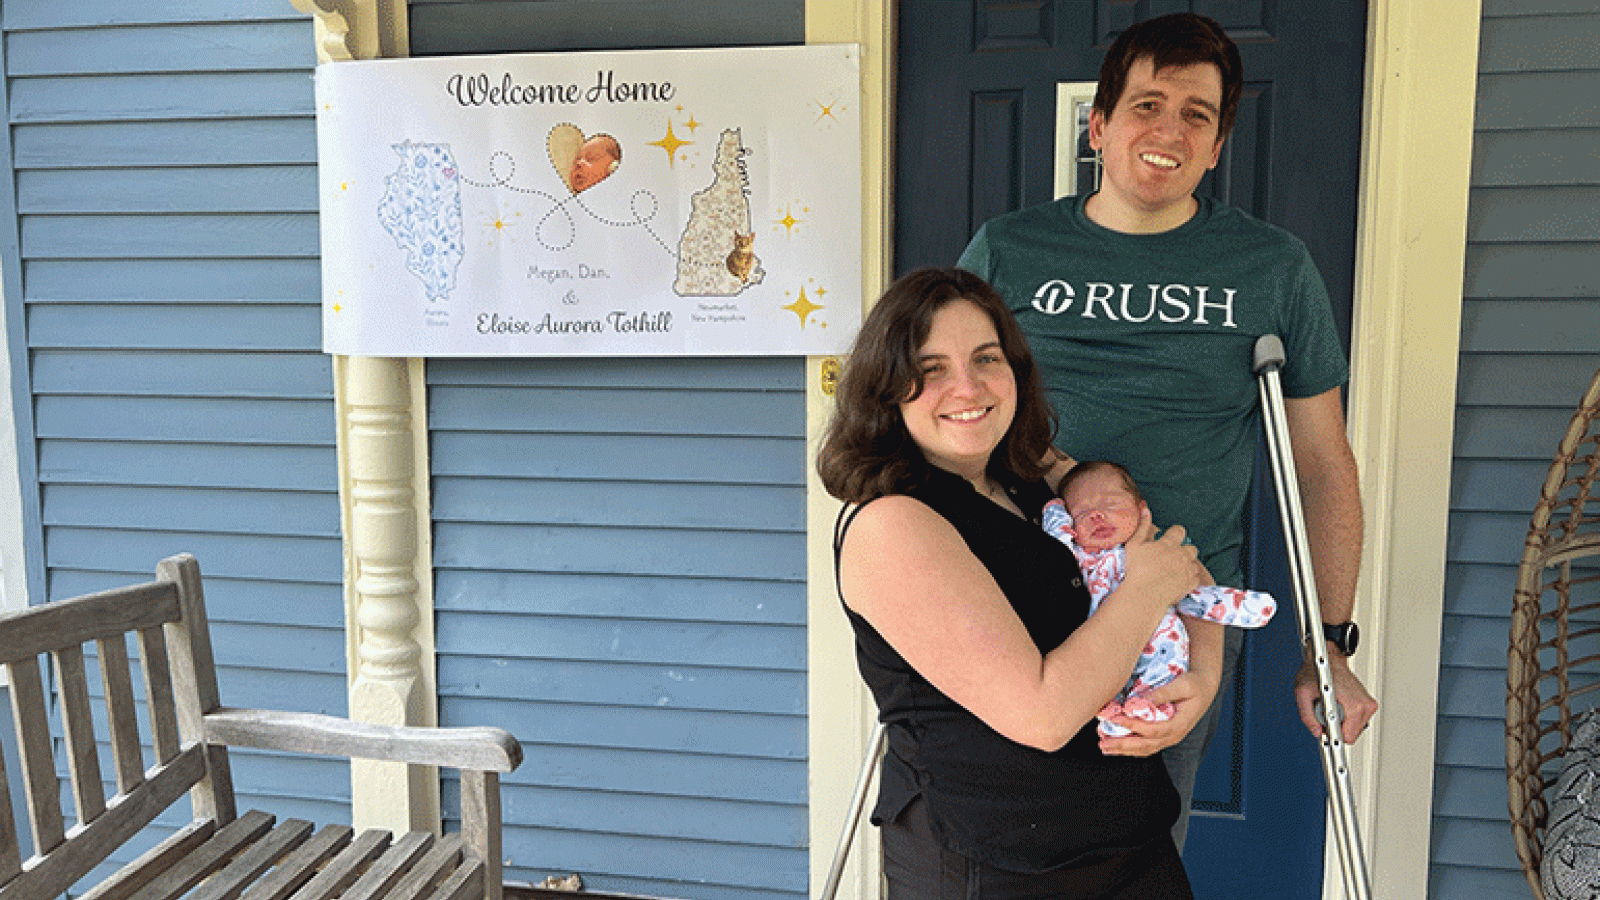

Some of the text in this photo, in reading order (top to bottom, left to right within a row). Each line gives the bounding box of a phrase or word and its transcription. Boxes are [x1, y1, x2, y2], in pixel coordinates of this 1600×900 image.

[446, 70, 677, 107] Welcome Home
[526, 263, 611, 284] Megan, Dan,
[561, 289, 580, 305] &
[1081, 281, 1238, 328] RUSH
[476, 310, 674, 334] Eloise Aurora Tothill
